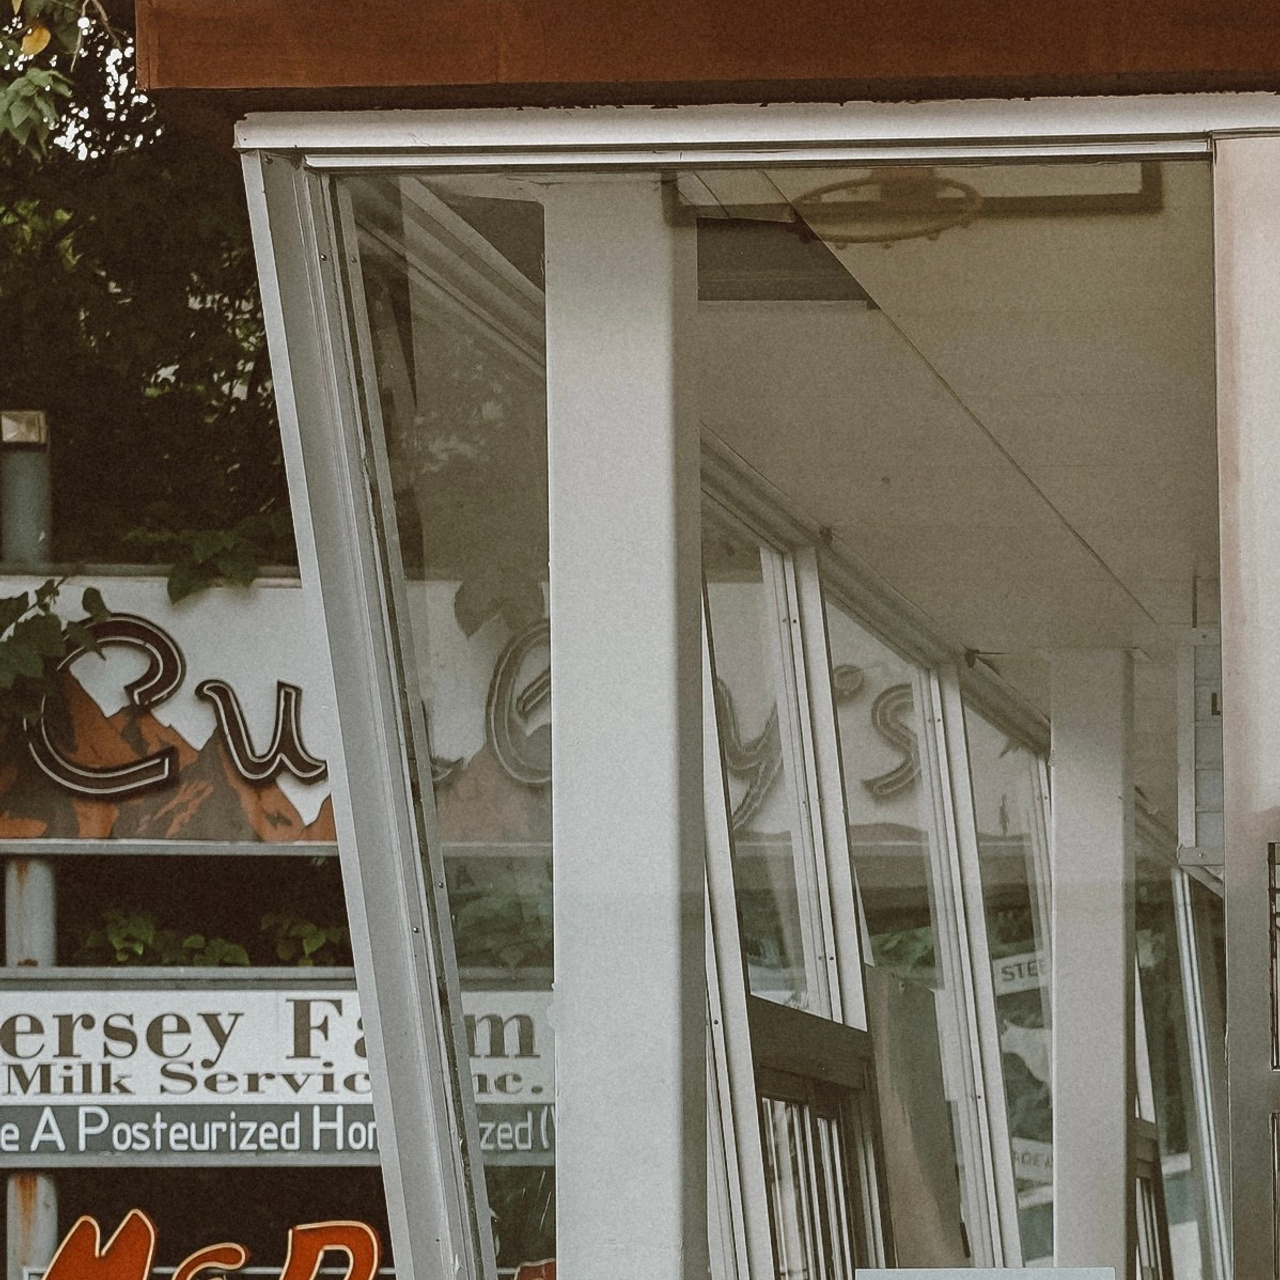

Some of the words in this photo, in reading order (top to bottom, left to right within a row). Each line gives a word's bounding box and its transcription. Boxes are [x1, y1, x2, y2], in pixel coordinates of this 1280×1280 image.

[0, 1012, 245, 1069] ersey
[286, 998, 541, 1060] Fm
[3, 1061, 136, 1096] Milk
[159, 1059, 373, 1096] Servic
[472, 1071, 545, 1096] nc.
